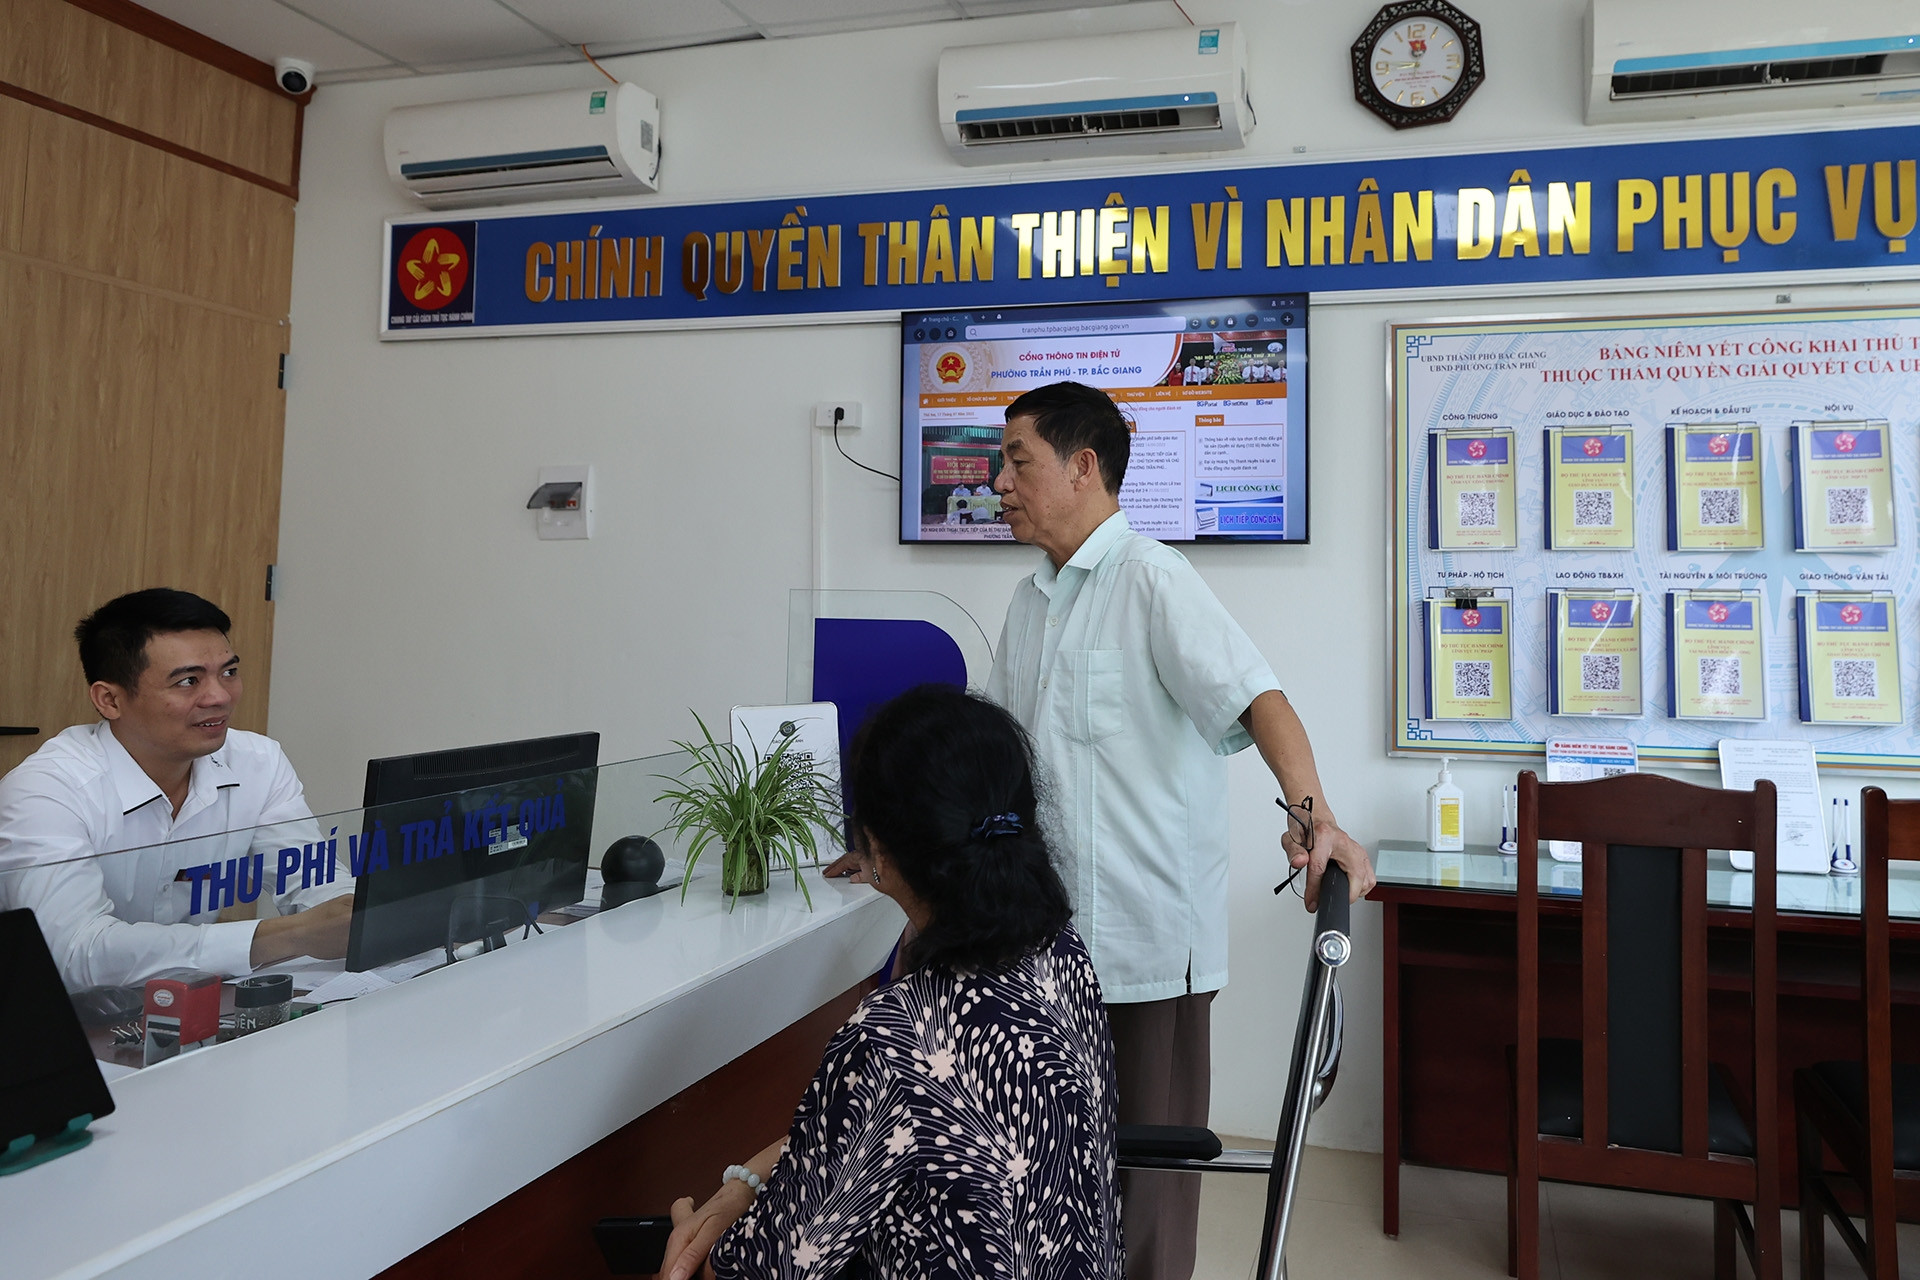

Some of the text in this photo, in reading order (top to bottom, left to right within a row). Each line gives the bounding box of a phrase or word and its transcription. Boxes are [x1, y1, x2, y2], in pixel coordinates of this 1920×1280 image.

[1407, 24, 1426, 39] 12
[1446, 54, 1460, 69] 3
[1375, 61, 1390, 76] 9
[1410, 91, 1425, 107] 6
[524, 159, 1917, 302] CHÍNH QUYỀN THÂN THIỆN VÌ NHÂN DÂN PHỤC VỤ
[1022, 323, 1130, 334] tranphu.tpbacgiang.bacgiang.gov.vn
[1600, 343, 1649, 360] BẢNG
[1653, 340, 1702, 358] NIÊM
[1707, 339, 1744, 357] YẾT
[1748, 337, 1802, 355] CÔNG
[1809, 338, 1857, 354] KHAI
[1863, 333, 1904, 352] THỦ
[1019, 350, 1043, 361] CỔNG
[1045, 350, 1073, 360] THÔNG
[1090, 350, 1108, 360] ĐIỆN
[1110, 349, 1121, 358] TỬ
[1421, 350, 1547, 362] UBND THÀNH PHỐ BẮC GIANG
[991, 367, 1027, 378] PHƯỜNG
[1030, 366, 1051, 377] TRẦN
[1054, 367, 1071, 376] PHÚ
[1078, 367, 1089, 376] TP.
[1091, 364, 1110, 375] BẮC
[1112, 365, 1142, 375] GIANG
[1454, 362, 1493, 372] PHƯỜNG
[1493, 361, 1518, 371] TRẦN
[1520, 359, 1538, 370] PHÚ
[1540, 368, 1604, 385] THUỘC
[1607, 363, 1662, 381] THẨM
[1666, 361, 1731, 382] QUYỀN
[1736, 358, 1778, 377] GIẢI
[1783, 357, 1850, 377] QUYẾT
[1854, 355, 1895, 374] CỦA
[1546, 409, 1566, 418] GIÁO
[1568, 411, 1585, 419] DỤC
[1594, 409, 1612, 418] ĐÀO
[1613, 410, 1630, 418] TẠO
[1671, 405, 1681, 415] KẾ
[1682, 407, 1713, 416] HOẠCH
[1722, 405, 1740, 415] ĐẦU
[1742, 406, 1752, 414] TƯ
[1824, 403, 1854, 413] NỘI VỤ
[1442, 411, 1498, 421] CÔNG THƯƠNG
[1437, 571, 1447, 579] TƯ
[1448, 569, 1468, 579] PHÁP
[1474, 571, 1485, 580] HỘ
[1486, 571, 1505, 580] TỊCH
[1573, 571, 1597, 580] ĐỘNG
[1659, 571, 1672, 580] TÀI
[1673, 571, 1707, 580] NGUYÊN
[1715, 571, 1732, 580] MÔI
[1733, 571, 1768, 580] TRƯỜNG
[1799, 571, 1889, 582] GIAO THÔNG VẬN TẢI
[186, 854, 264, 916] THU
[276, 825, 338, 895] PHÍ
[349, 819, 390, 878] VÀ
[400, 800, 455, 867] TRẢ
[463, 792, 509, 852] KẾT
[519, 778, 566, 841] QUẢ
